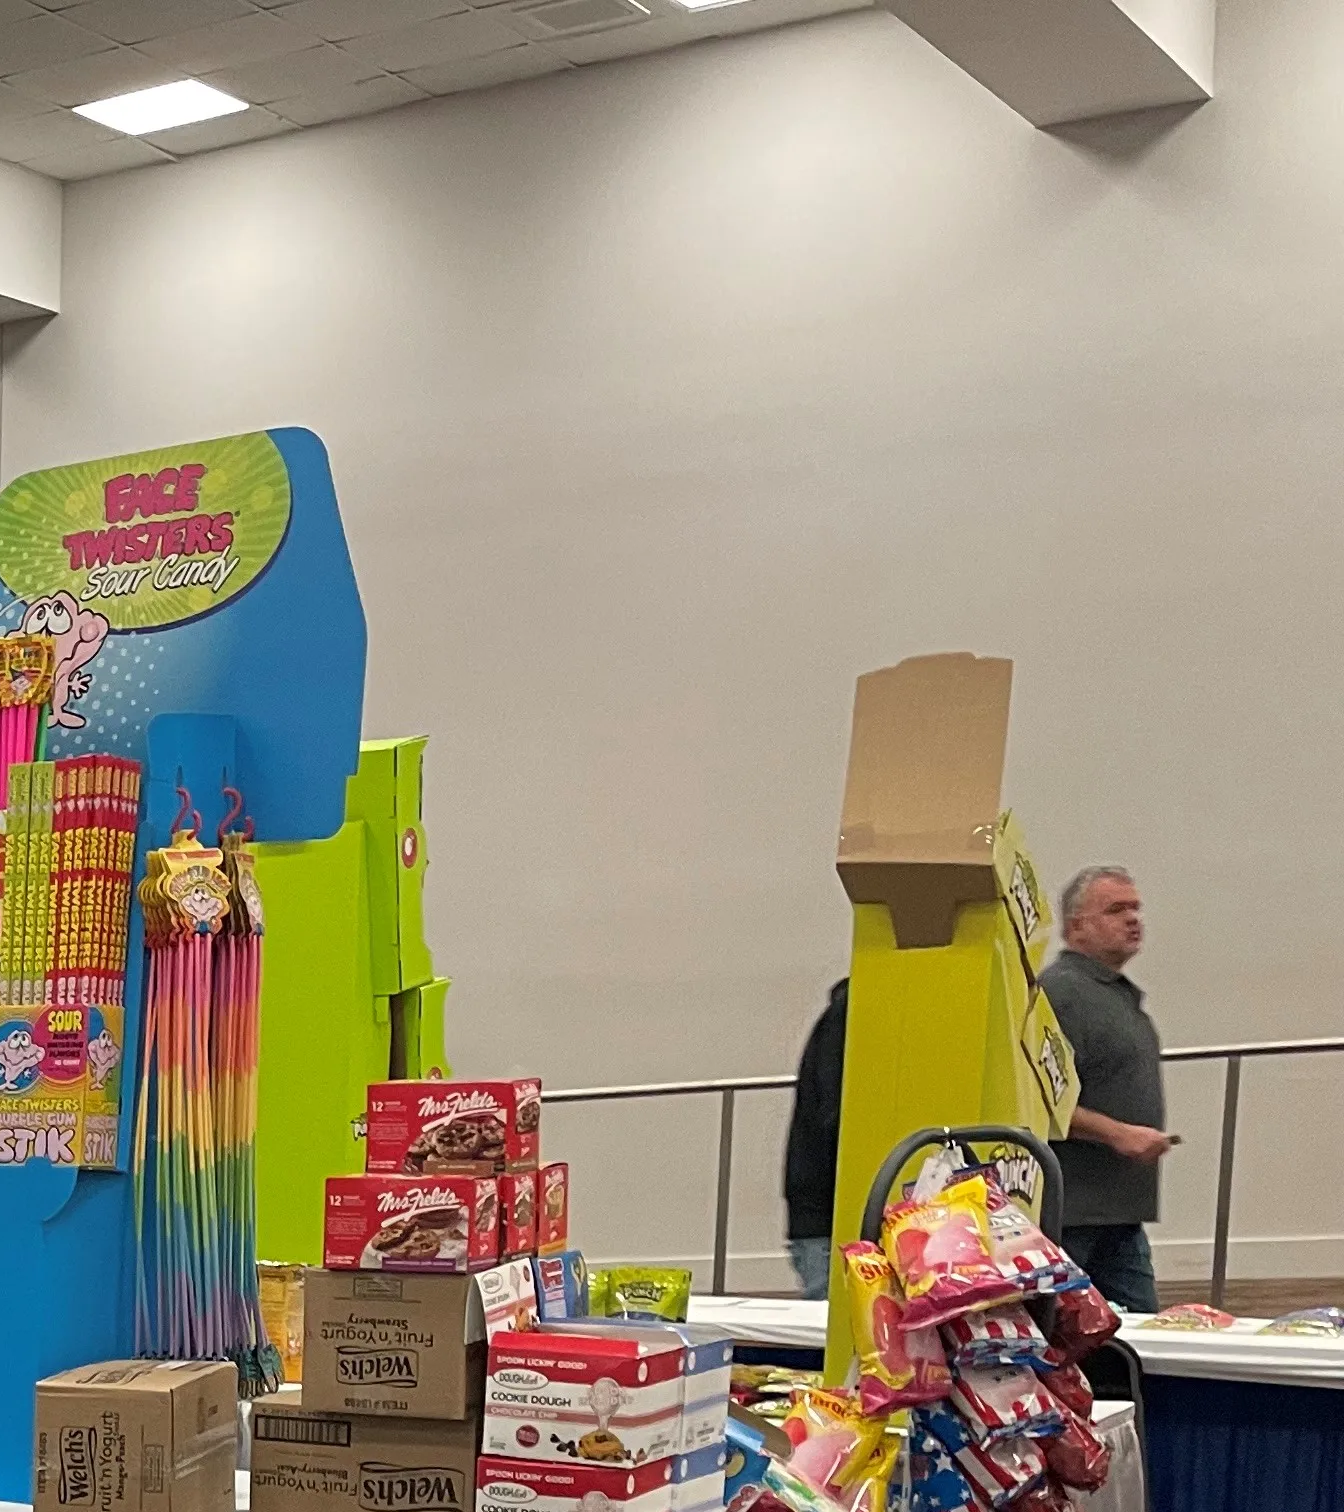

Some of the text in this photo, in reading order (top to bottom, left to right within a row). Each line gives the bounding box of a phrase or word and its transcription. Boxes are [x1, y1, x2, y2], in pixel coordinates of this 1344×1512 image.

[103, 463, 208, 524] FACE
[62, 511, 235, 571] TWISTERS
[79, 545, 241, 602] Sour Candy
[47, 1010, 83, 1032] SOUR
[24, 1099, 81, 1111] TWISTERS
[372, 1101, 383, 1112] 12
[46, 1113, 77, 1125] GUM
[84, 1131, 115, 1163] STIK
[330, 1195, 341, 1206] 12
[347, 1314, 409, 1329] Strawberry
[320, 1327, 377, 1344] Yogurt
[395, 1331, 434, 1347] Fruit
[340, 1356, 416, 1379] Welch's
[496, 1356, 525, 1365] SPOON
[491, 1392, 572, 1407] COOKIE DOUGH
[490, 1407, 558, 1419] CHOCOLATE CHIP
[100, 1410, 116, 1466] Yogurt
[65, 1429, 88, 1501] Welch's
[485, 1469, 514, 1478] SPOON
[254, 1474, 305, 1491] Yogurt
[321, 1480, 358, 1496] Fruit
[363, 1477, 460, 1505] Welch's
